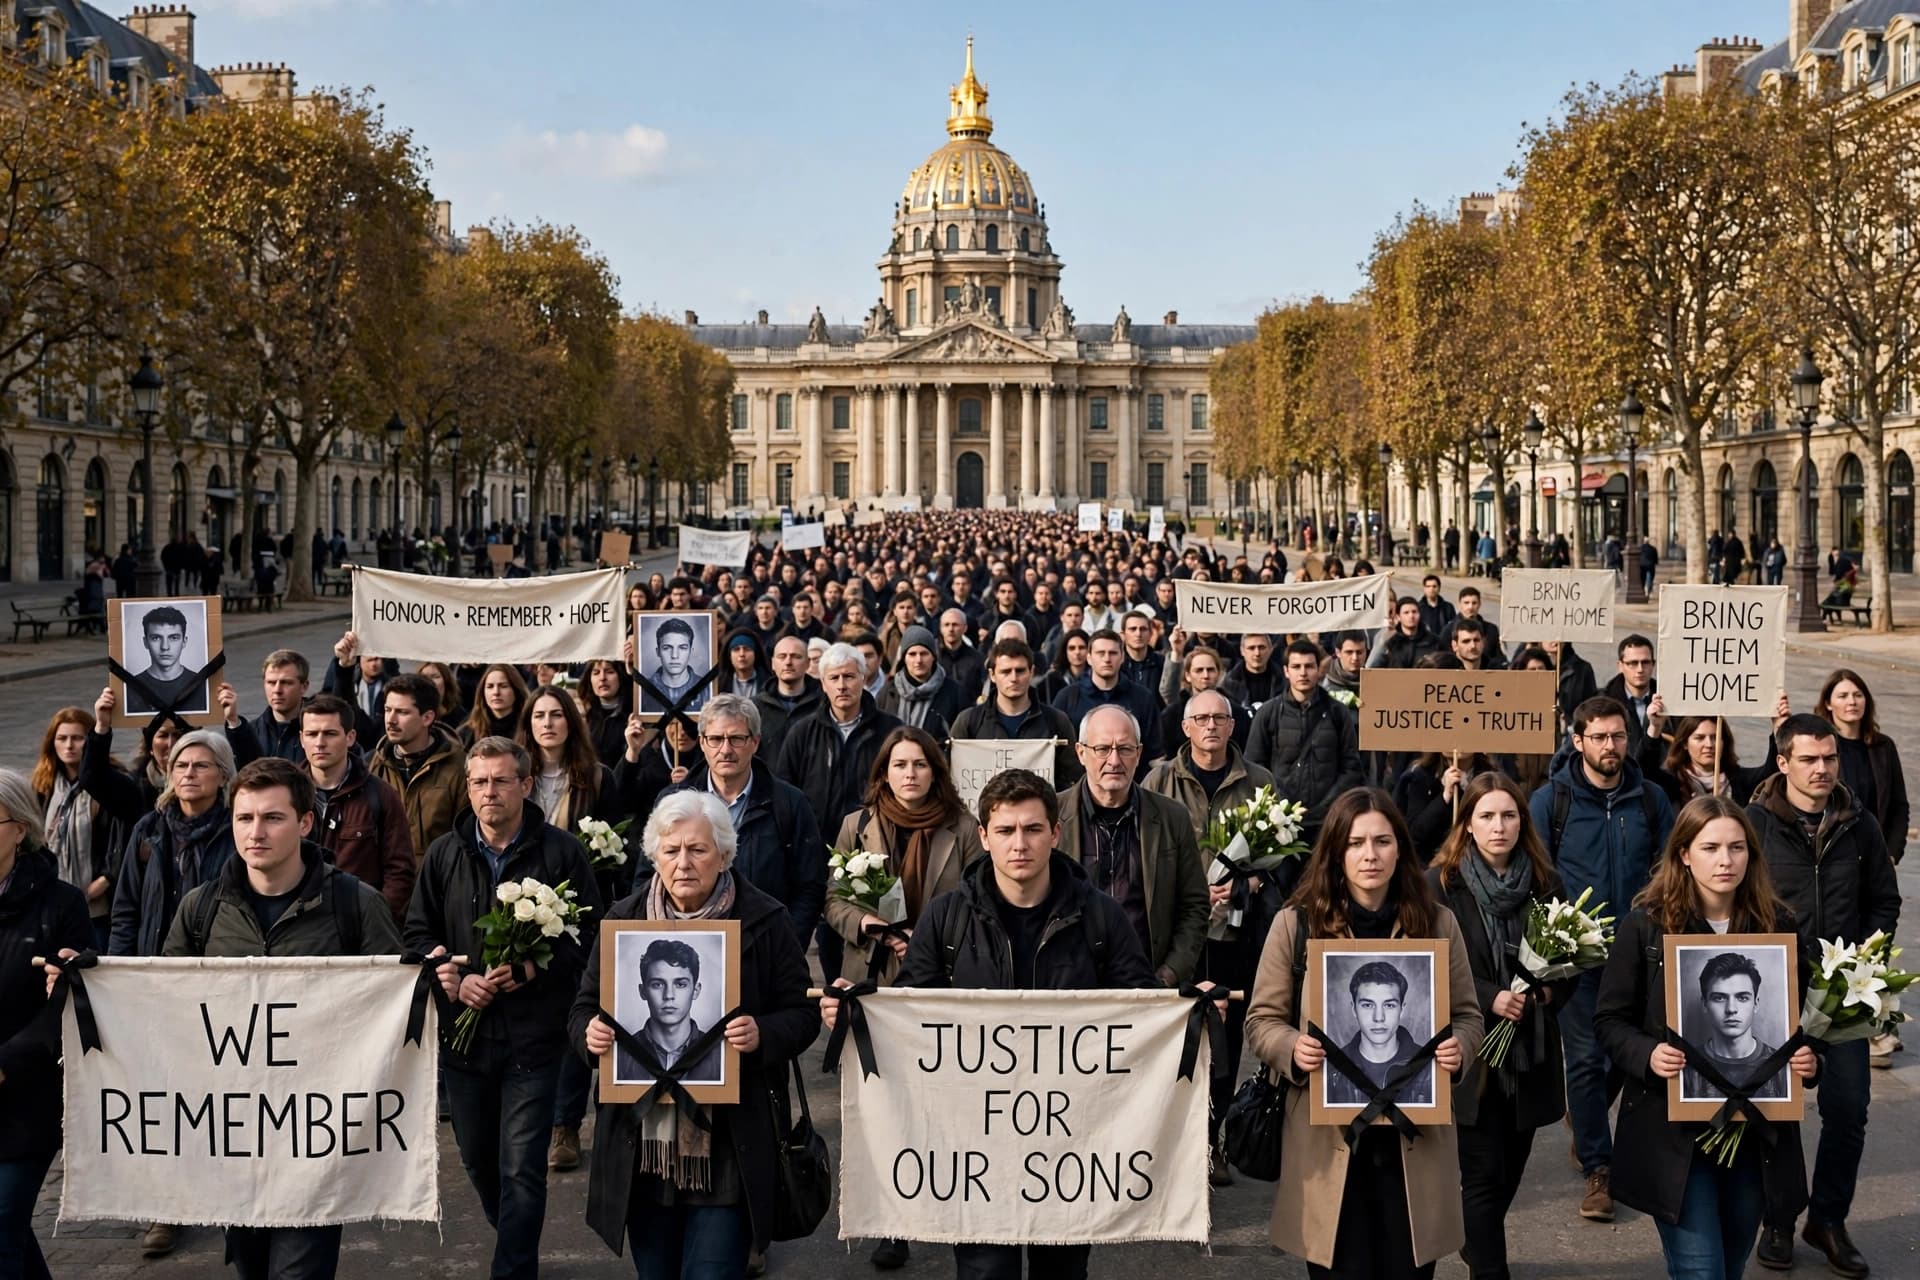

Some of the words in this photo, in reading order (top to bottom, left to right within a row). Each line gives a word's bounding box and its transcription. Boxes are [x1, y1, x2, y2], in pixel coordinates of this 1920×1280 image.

[1191, 596, 1253, 616] NEVER
[1267, 592, 1376, 616] FORGOTTEN
[1533, 581, 1581, 601] BRING
[372, 599, 445, 626] HONOUR
[467, 605, 552, 627] REMEMBER
[570, 601, 611, 625] HOPE
[1564, 607, 1608, 627] HOME
[1683, 600, 1764, 630] BRING
[1683, 637, 1759, 666] THEM
[1424, 683, 1486, 704] PEACE
[1682, 672, 1759, 702] HOME
[1374, 710, 1454, 730] JUSTICE
[1477, 711, 1543, 731] TRUTH
[200, 1002, 298, 1067] WE
[918, 1022, 1133, 1075] JUSTICE
[100, 1088, 408, 1158] REMEMBER
[984, 1090, 1072, 1137] FOR
[893, 1148, 991, 1202] OUR
[1021, 1150, 1154, 1203] SONS
